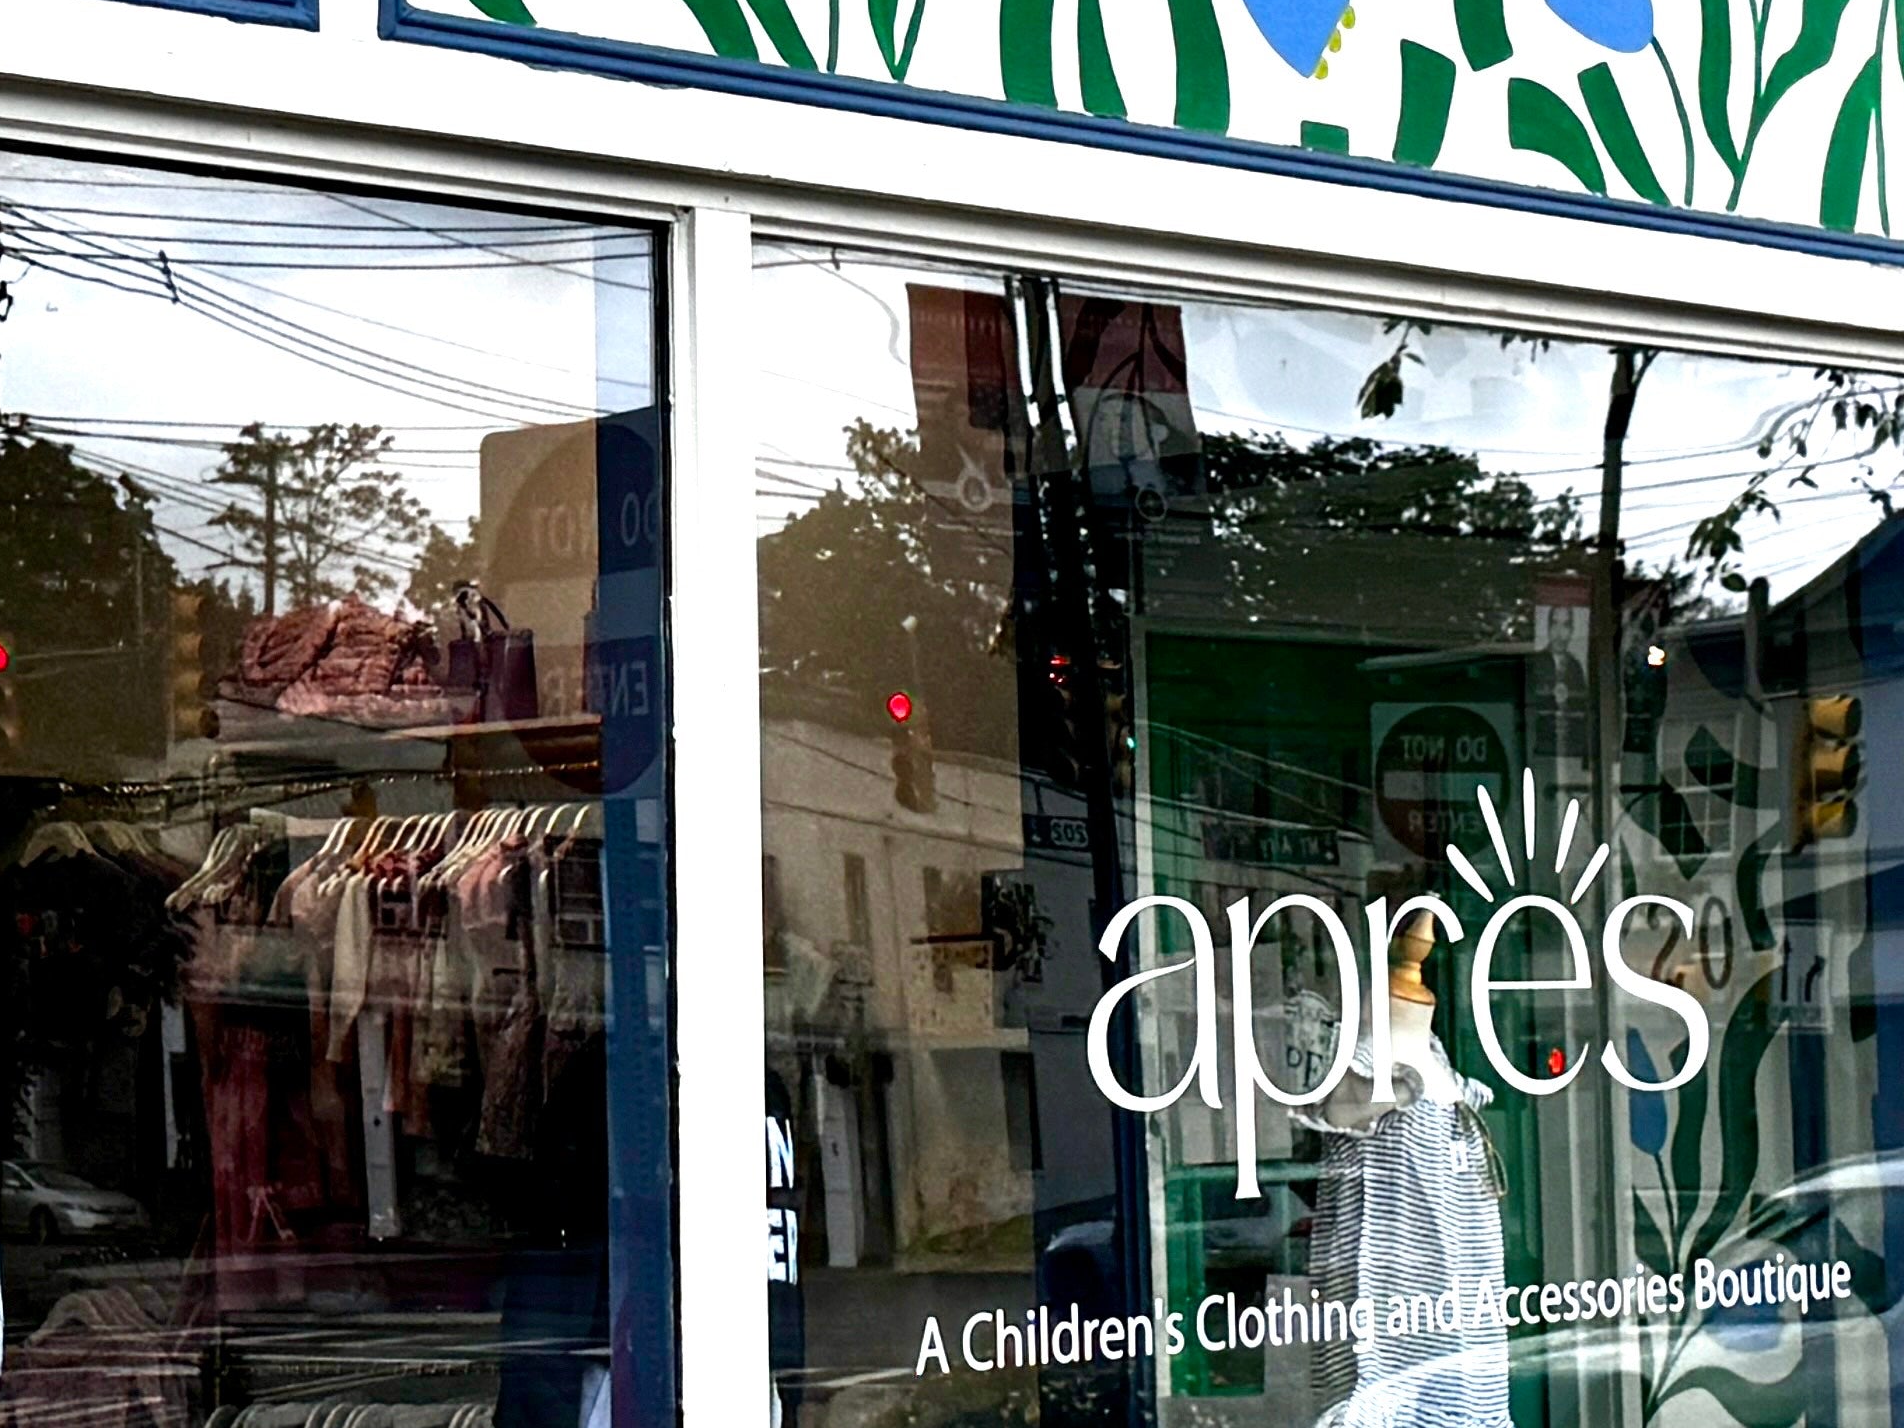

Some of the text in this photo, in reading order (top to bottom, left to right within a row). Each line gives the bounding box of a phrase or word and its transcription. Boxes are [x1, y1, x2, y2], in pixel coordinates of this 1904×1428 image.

[915, 1253, 1852, 1376] A Children's Clothing and Accessories Boutique
